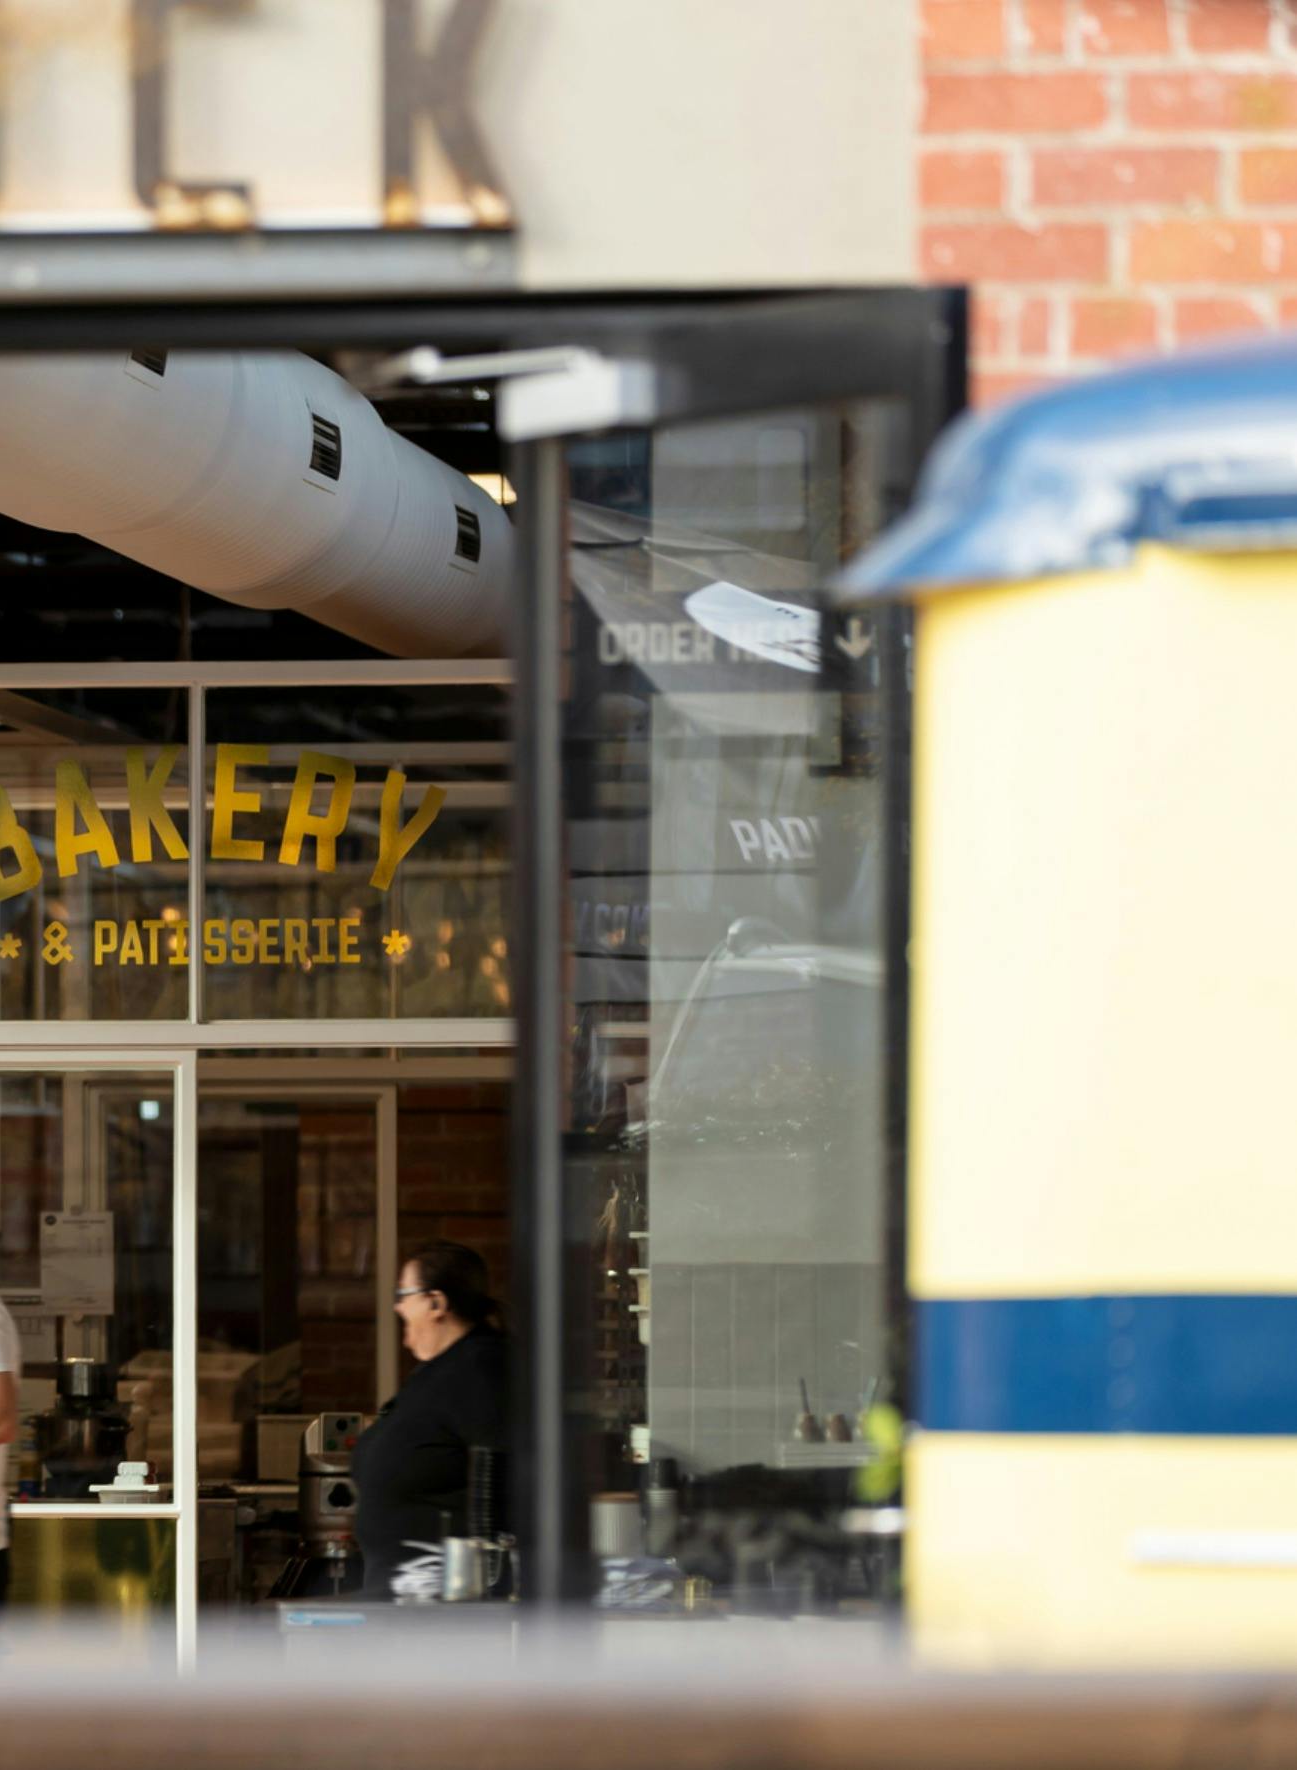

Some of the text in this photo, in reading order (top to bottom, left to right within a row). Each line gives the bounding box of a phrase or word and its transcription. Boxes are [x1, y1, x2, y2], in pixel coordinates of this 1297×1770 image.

[597, 620, 716, 666] ORDER
[729, 816, 822, 862] PAD
[41, 917, 362, 966] & PATISSERIE
